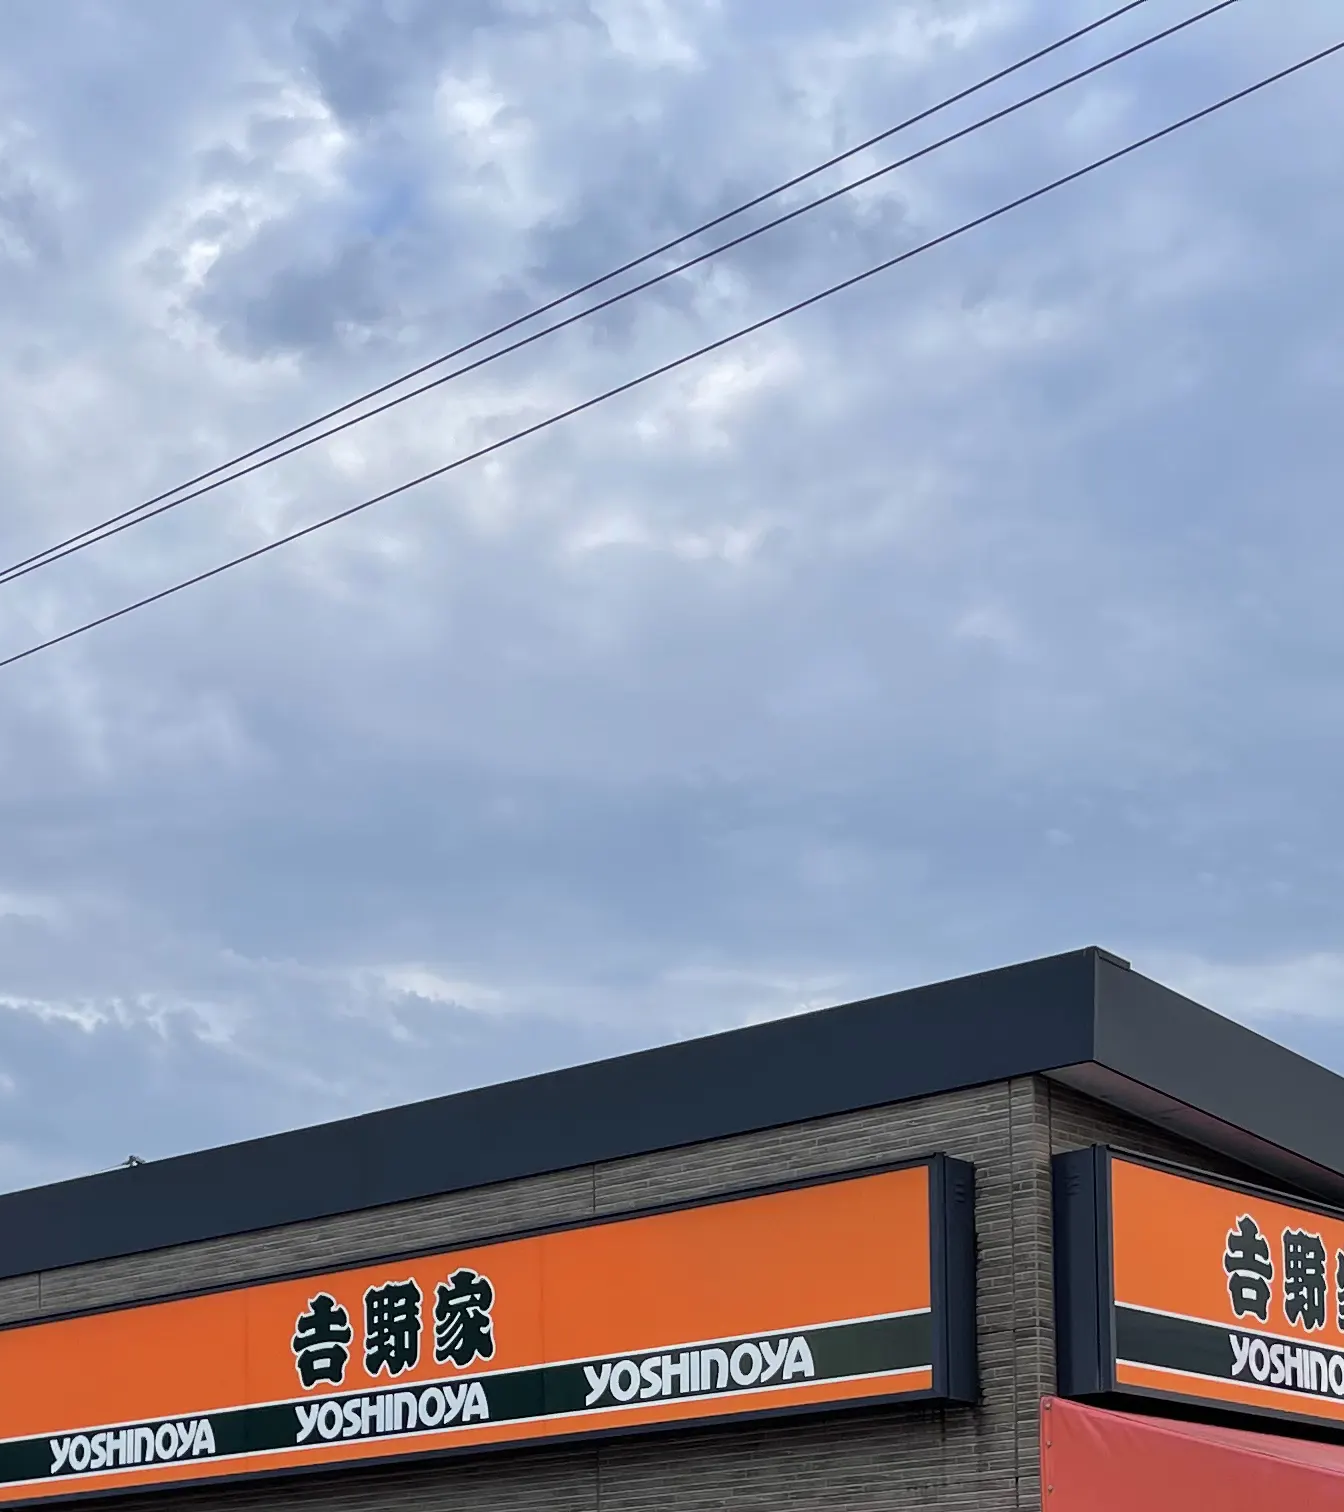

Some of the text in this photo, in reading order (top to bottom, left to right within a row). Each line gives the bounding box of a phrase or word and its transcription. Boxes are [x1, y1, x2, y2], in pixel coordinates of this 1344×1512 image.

[291, 1266, 496, 1389] 吉野家
[583, 1335, 815, 1407] YOSHINOYA
[295, 1382, 489, 1443] YOSHINOYA
[50, 1418, 216, 1475] YOSHINOYA
